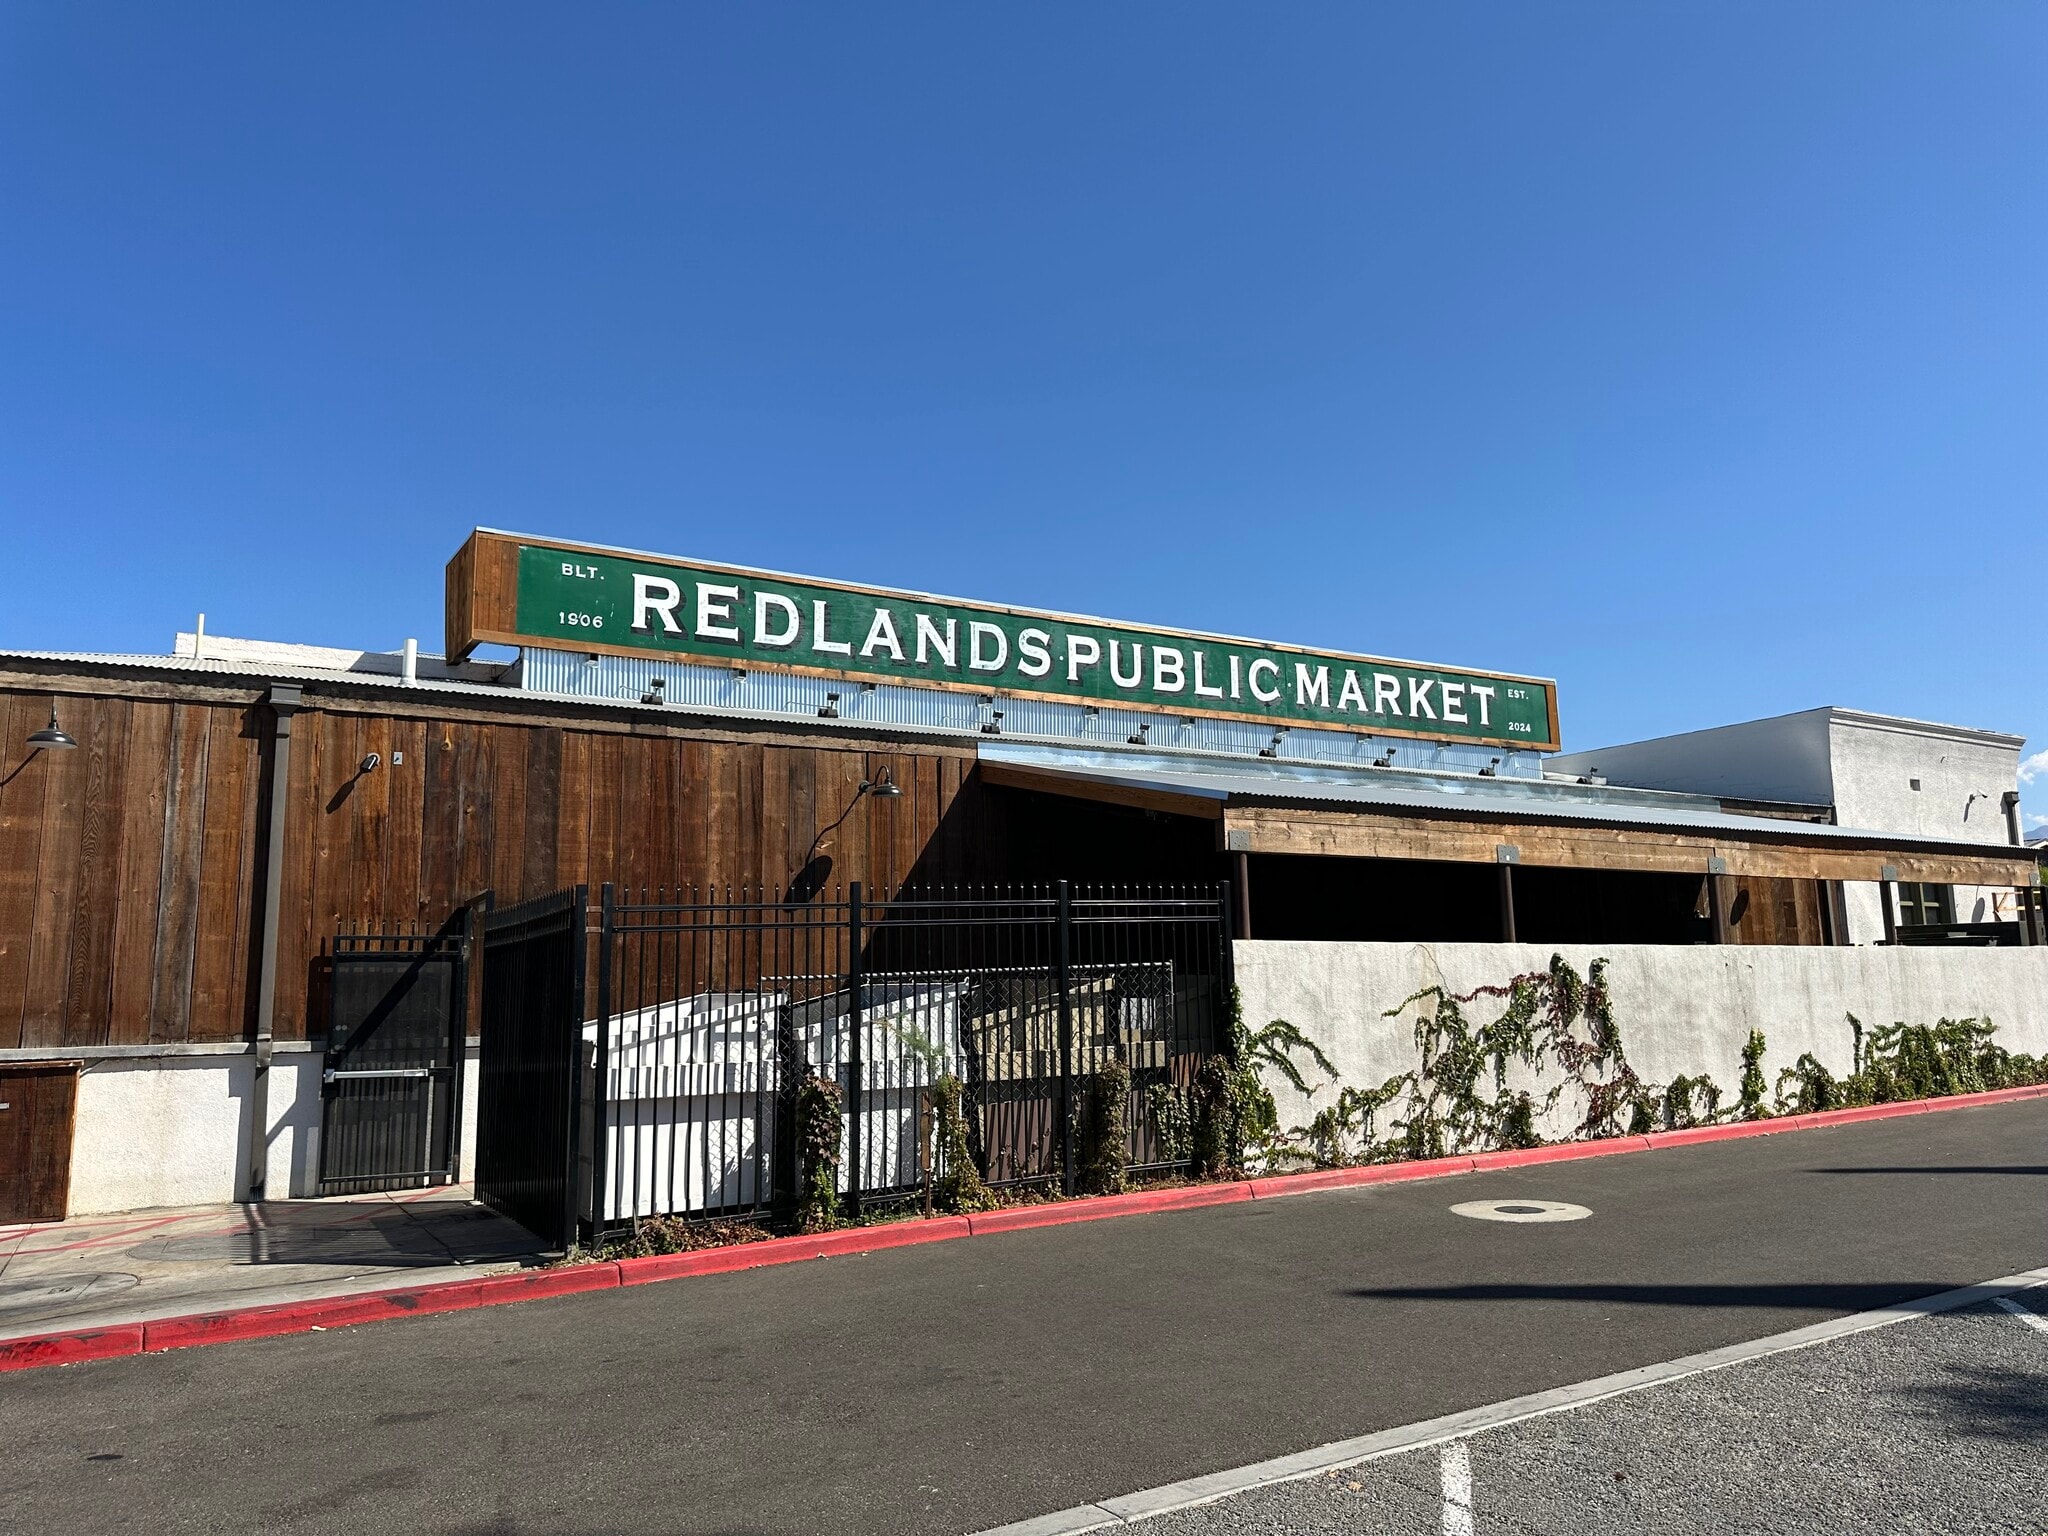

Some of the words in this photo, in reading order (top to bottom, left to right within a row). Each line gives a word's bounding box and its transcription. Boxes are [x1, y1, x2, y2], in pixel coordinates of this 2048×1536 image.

[561, 562, 605, 580] BLT.
[559, 611, 604, 629] 1906
[630, 573, 1052, 677] REDLANDS
[1065, 633, 1282, 702] PUBLIC
[1294, 661, 1496, 726] MARKET
[1507, 688, 1529, 700] EST.
[1508, 721, 1532, 733] 2024
